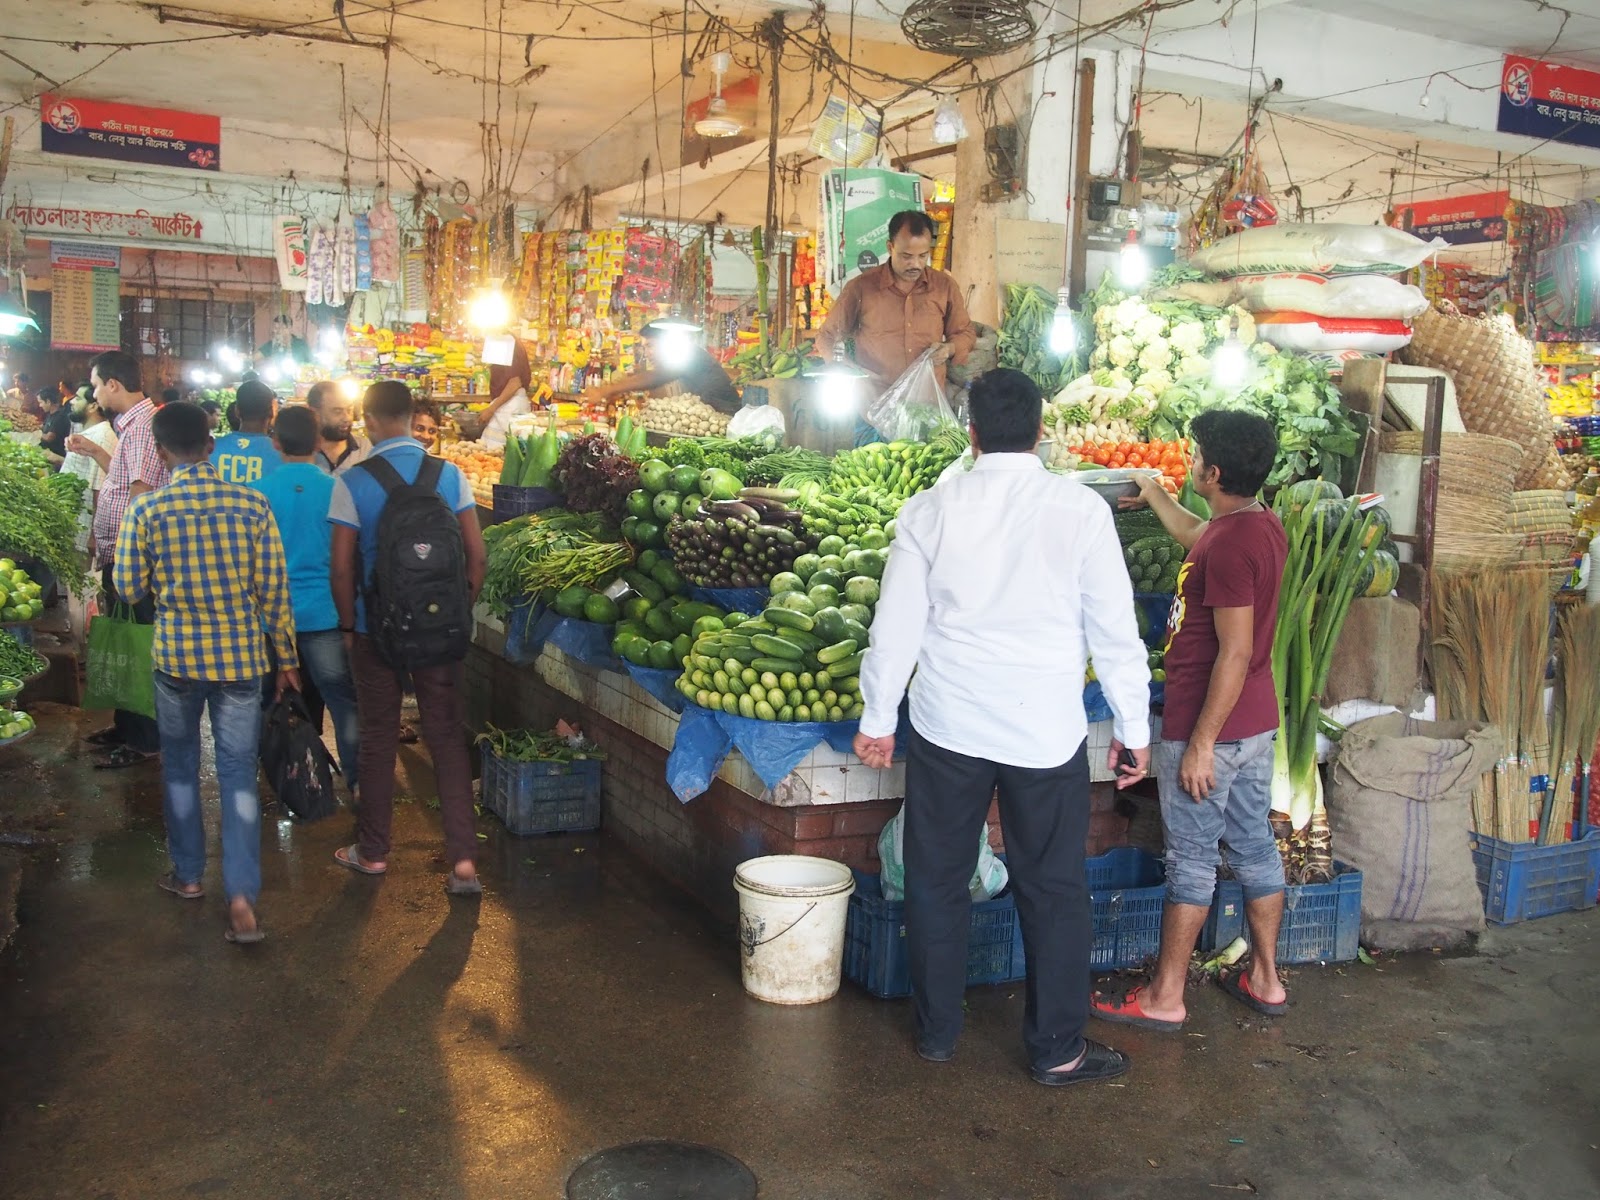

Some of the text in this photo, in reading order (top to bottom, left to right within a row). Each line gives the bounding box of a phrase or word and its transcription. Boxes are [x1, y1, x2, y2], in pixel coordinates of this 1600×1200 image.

[1548, 87, 1566, 101] কঠিন
[1553, 107, 1567, 122] লেবু
[1568, 110, 1581, 121] আর
[101, 119, 122, 131] কঠিন
[124, 124, 137, 132] দাগ
[139, 125, 151, 136] দূর
[108, 134, 126, 147] লেবু
[128, 137, 143, 146] আর
[145, 136, 168, 149] নীলের
[170, 140, 187, 151] শক্তি
[150, 213, 193, 237] মার্কেট
